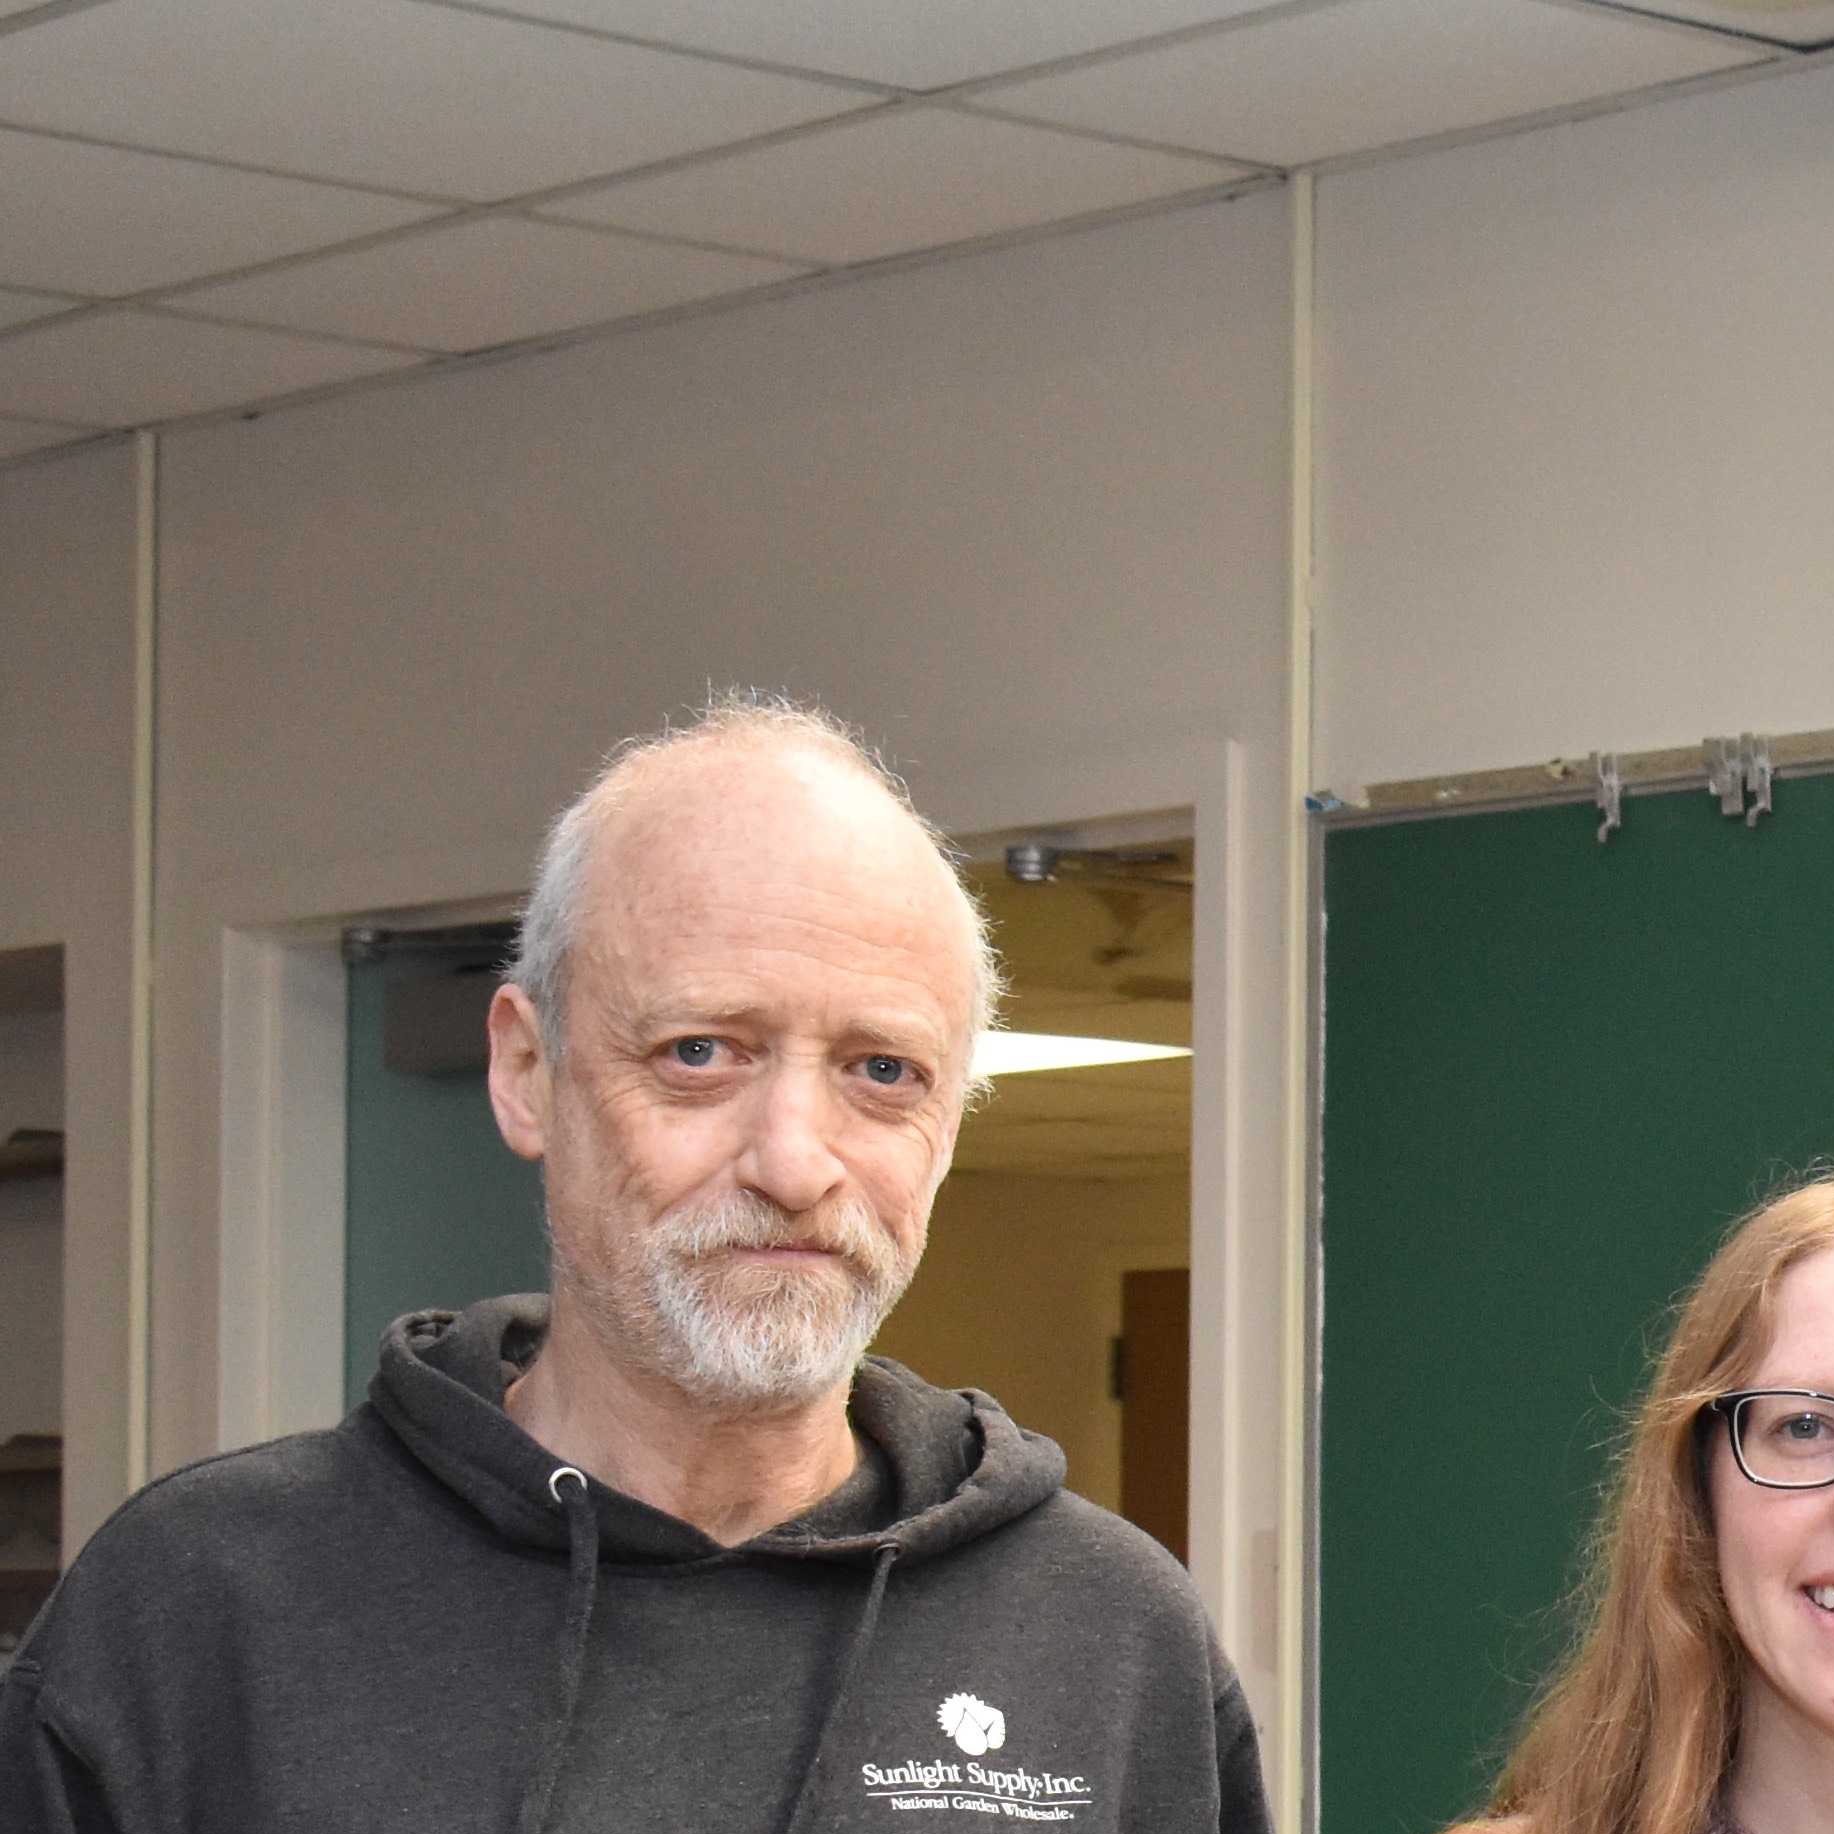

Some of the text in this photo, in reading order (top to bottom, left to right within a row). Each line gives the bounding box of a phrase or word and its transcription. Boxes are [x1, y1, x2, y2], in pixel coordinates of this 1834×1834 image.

[861, 1759, 963, 1789] Sunlight
[1042, 1772, 1093, 1795] Inc.
[890, 1795, 950, 1811] National
[951, 1796, 1001, 1814] Garden
